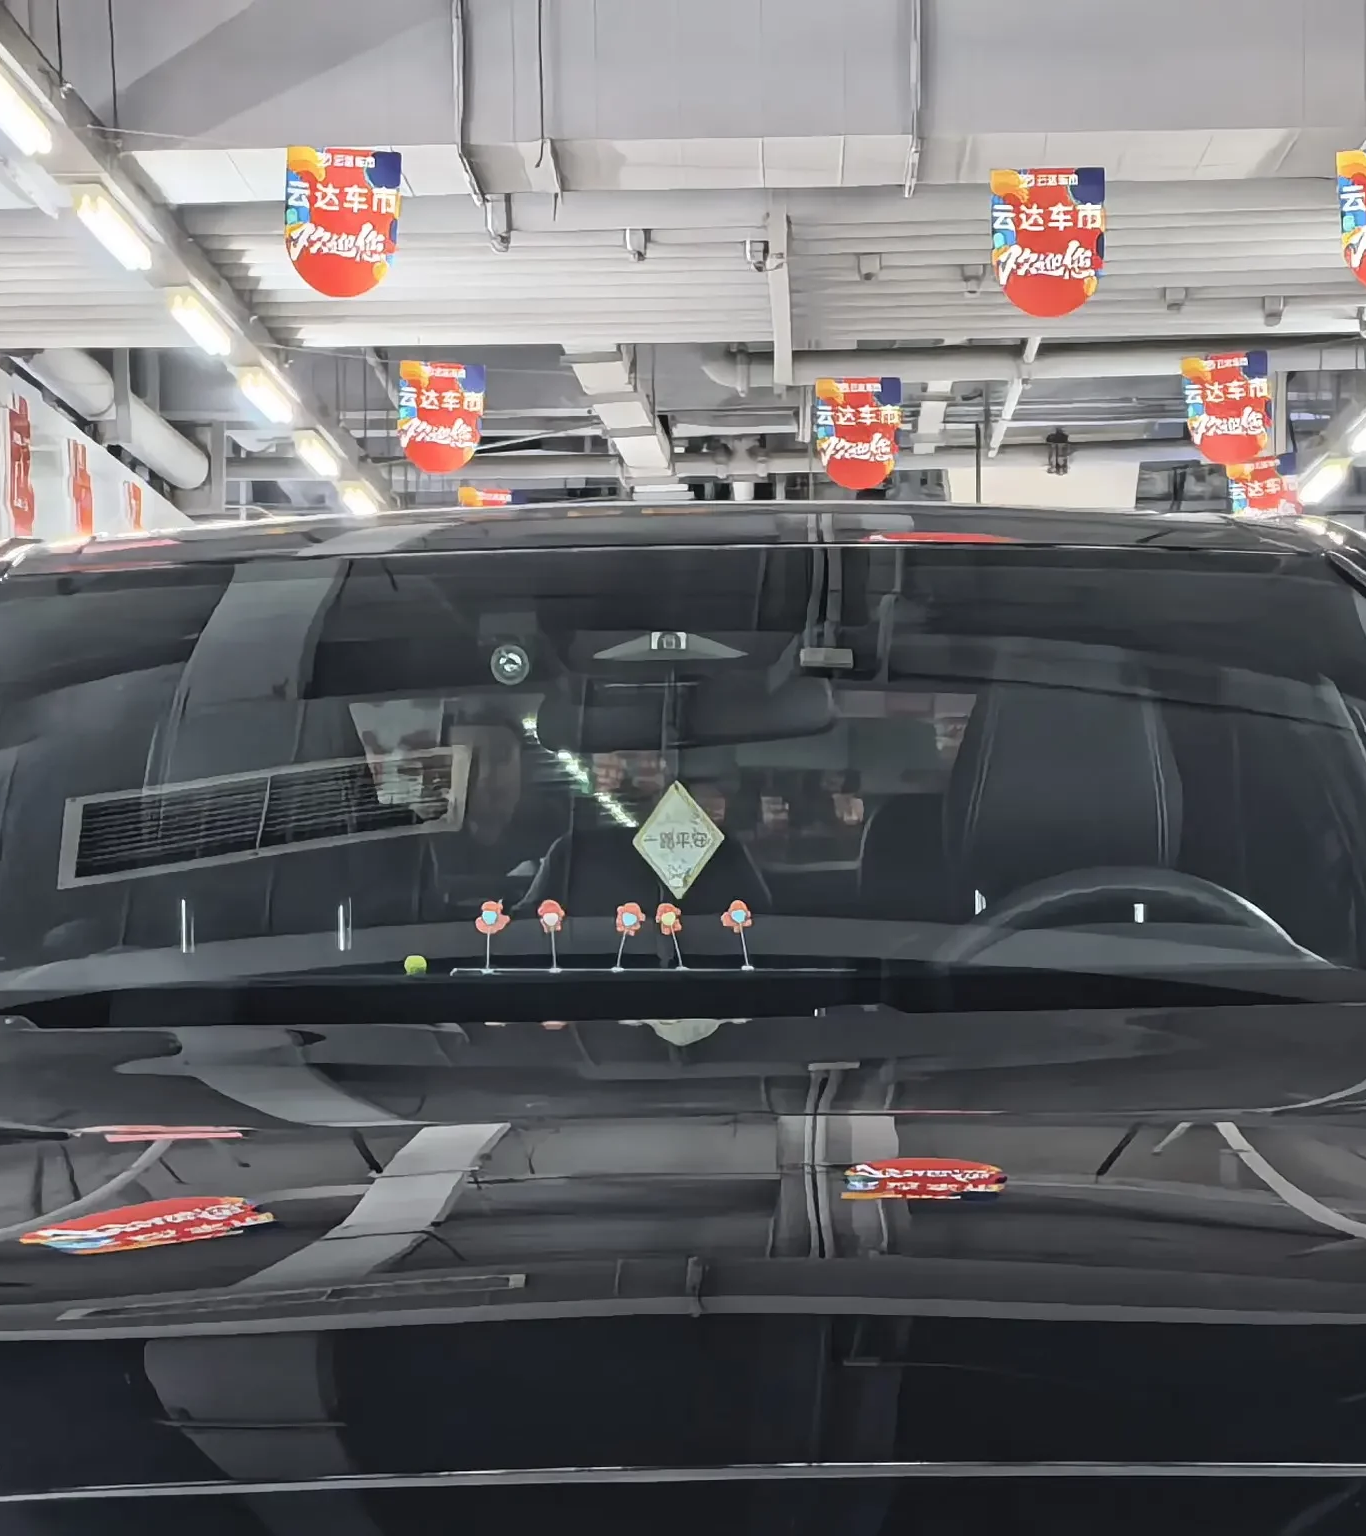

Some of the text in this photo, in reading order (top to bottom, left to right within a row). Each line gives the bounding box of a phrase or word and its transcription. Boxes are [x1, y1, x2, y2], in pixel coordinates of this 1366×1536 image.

[287, 181, 396, 214] 云达车市
[993, 203, 1102, 231] 云达车市
[290, 222, 387, 263] 欢迎您
[999, 240, 1096, 285] 欢迎您
[399, 387, 484, 414] 云达车市
[1185, 378, 1268, 403] 云达车市
[817, 404, 901, 426] 云达车市
[1192, 406, 1266, 445] 欢迎您
[400, 418, 475, 448] 欢迎您
[822, 433, 894, 466] 欢迎您
